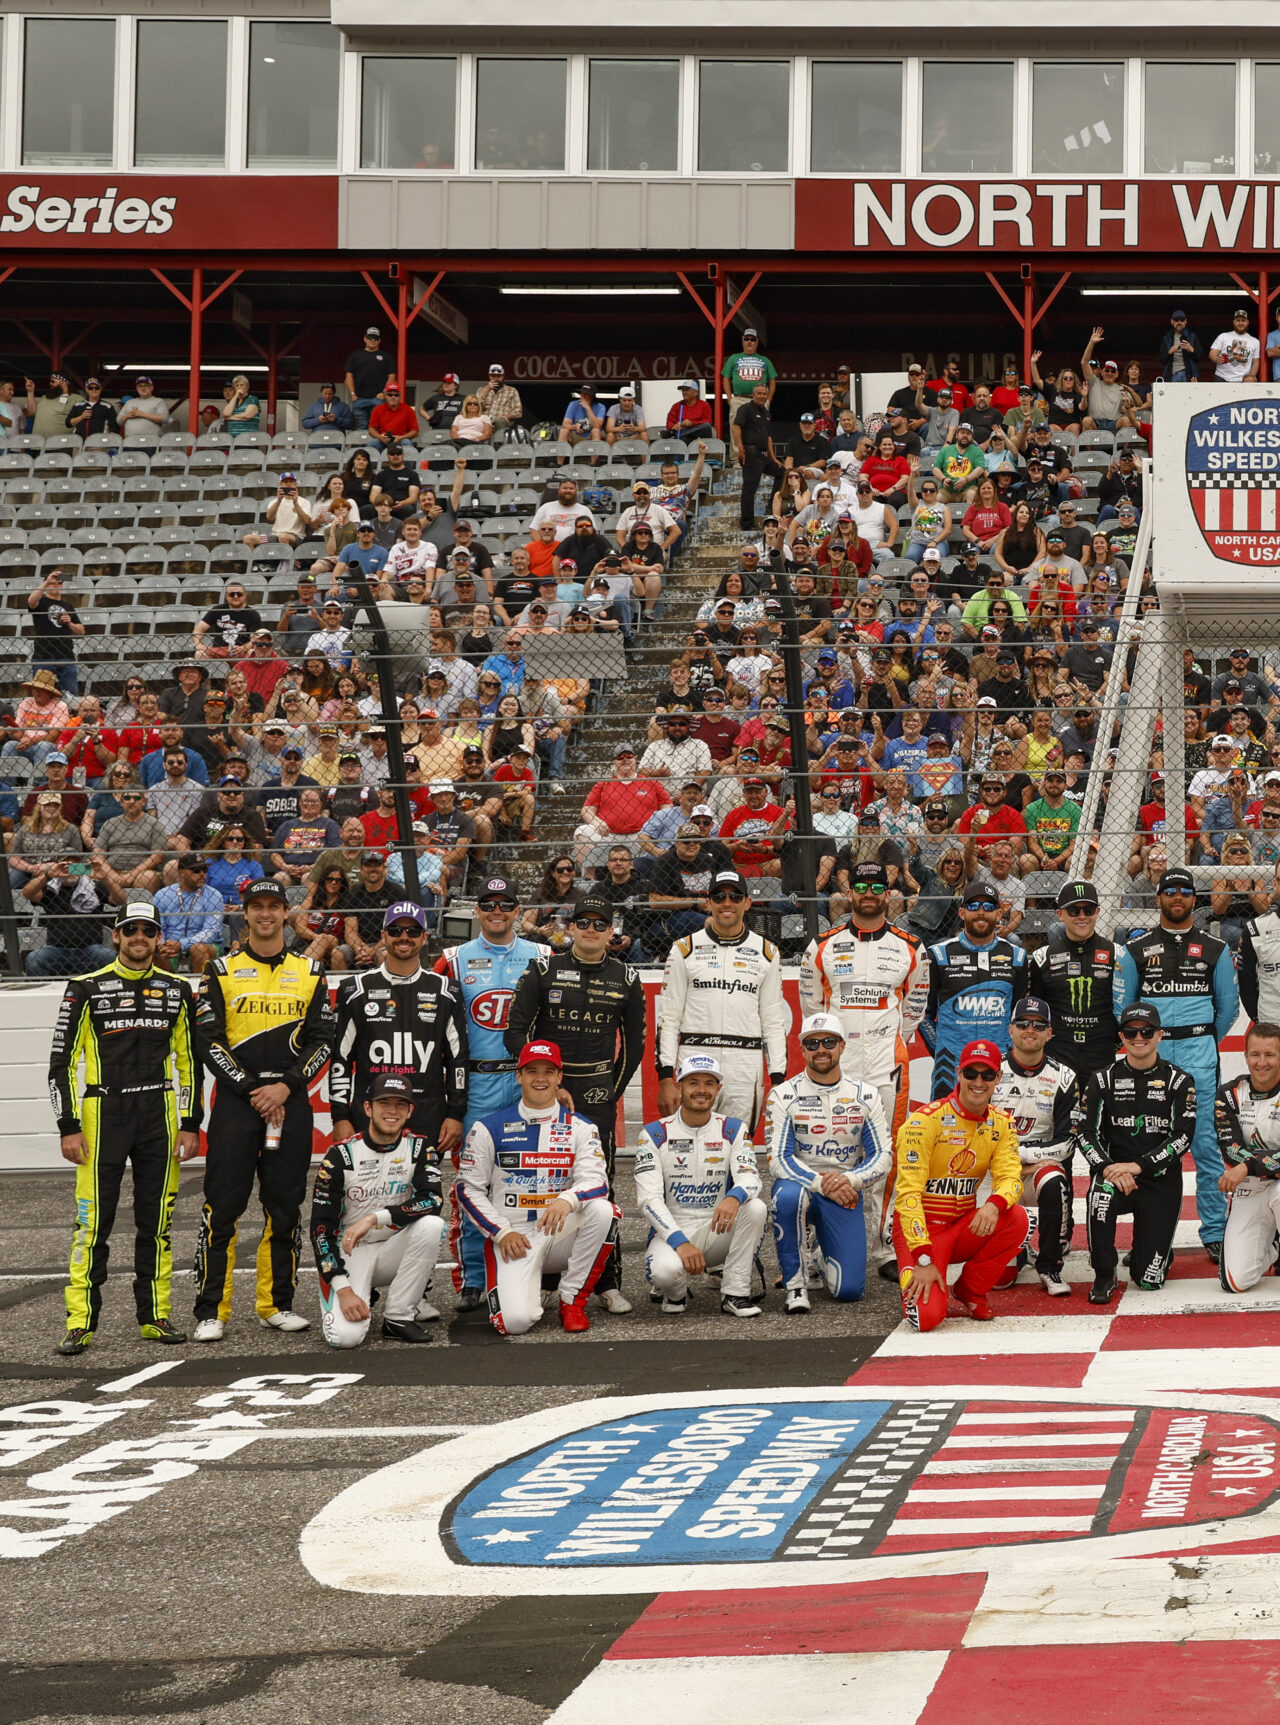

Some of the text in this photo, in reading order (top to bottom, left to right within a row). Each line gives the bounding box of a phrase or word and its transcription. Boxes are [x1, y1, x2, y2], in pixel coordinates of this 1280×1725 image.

[1, 186, 177, 234] Series
[853, 184, 1139, 248] NORTH
[514, 356, 645, 379] COCA-COLA
[1215, 535, 1257, 546] NORTH
[252, 883, 280, 893] ZEIGLER
[393, 903, 420, 917] ally
[692, 978, 758, 994] Smithfield
[854, 988, 890, 997] Schluter
[1152, 980, 1209, 993] Columbia
[236, 996, 305, 1017] ZEIGLER
[840, 996, 877, 1005] Systems
[958, 996, 1006, 1010] WWEX
[476, 994, 511, 1025] ST
[550, 1008, 614, 1024] LEGACY
[973, 1009, 1005, 1017] RACING
[104, 1018, 169, 1030] MENARDS
[557, 1024, 581, 1032] MOTOR
[1062, 1016, 1098, 1024] MONSTER
[701, 1037, 742, 1047] ALMIROLA
[369, 1032, 435, 1073] ally
[209, 1048, 246, 1083] ZEIGLER
[390, 1066, 416, 1074] right.
[329, 1063, 350, 1104] ally
[890, 1064, 902, 1094] 7
[583, 1087, 609, 1104] 42
[1145, 1115, 1169, 1128] Filte
[815, 1139, 860, 1162] Kroger
[525, 1156, 571, 1166] Motorcraft
[515, 1175, 571, 1186] Quick Lane
[669, 1181, 724, 1197] Hendrick
[521, 1198, 546, 1206] Omni
[1224, 1441, 1277, 1489] USA
[474, 1440, 618, 1520] NORTH
[546, 1407, 774, 1560] WILKESBORO
[686, 1416, 860, 1539] SPEEDWAY
[1141, 1465, 1188, 1518] NORTH
